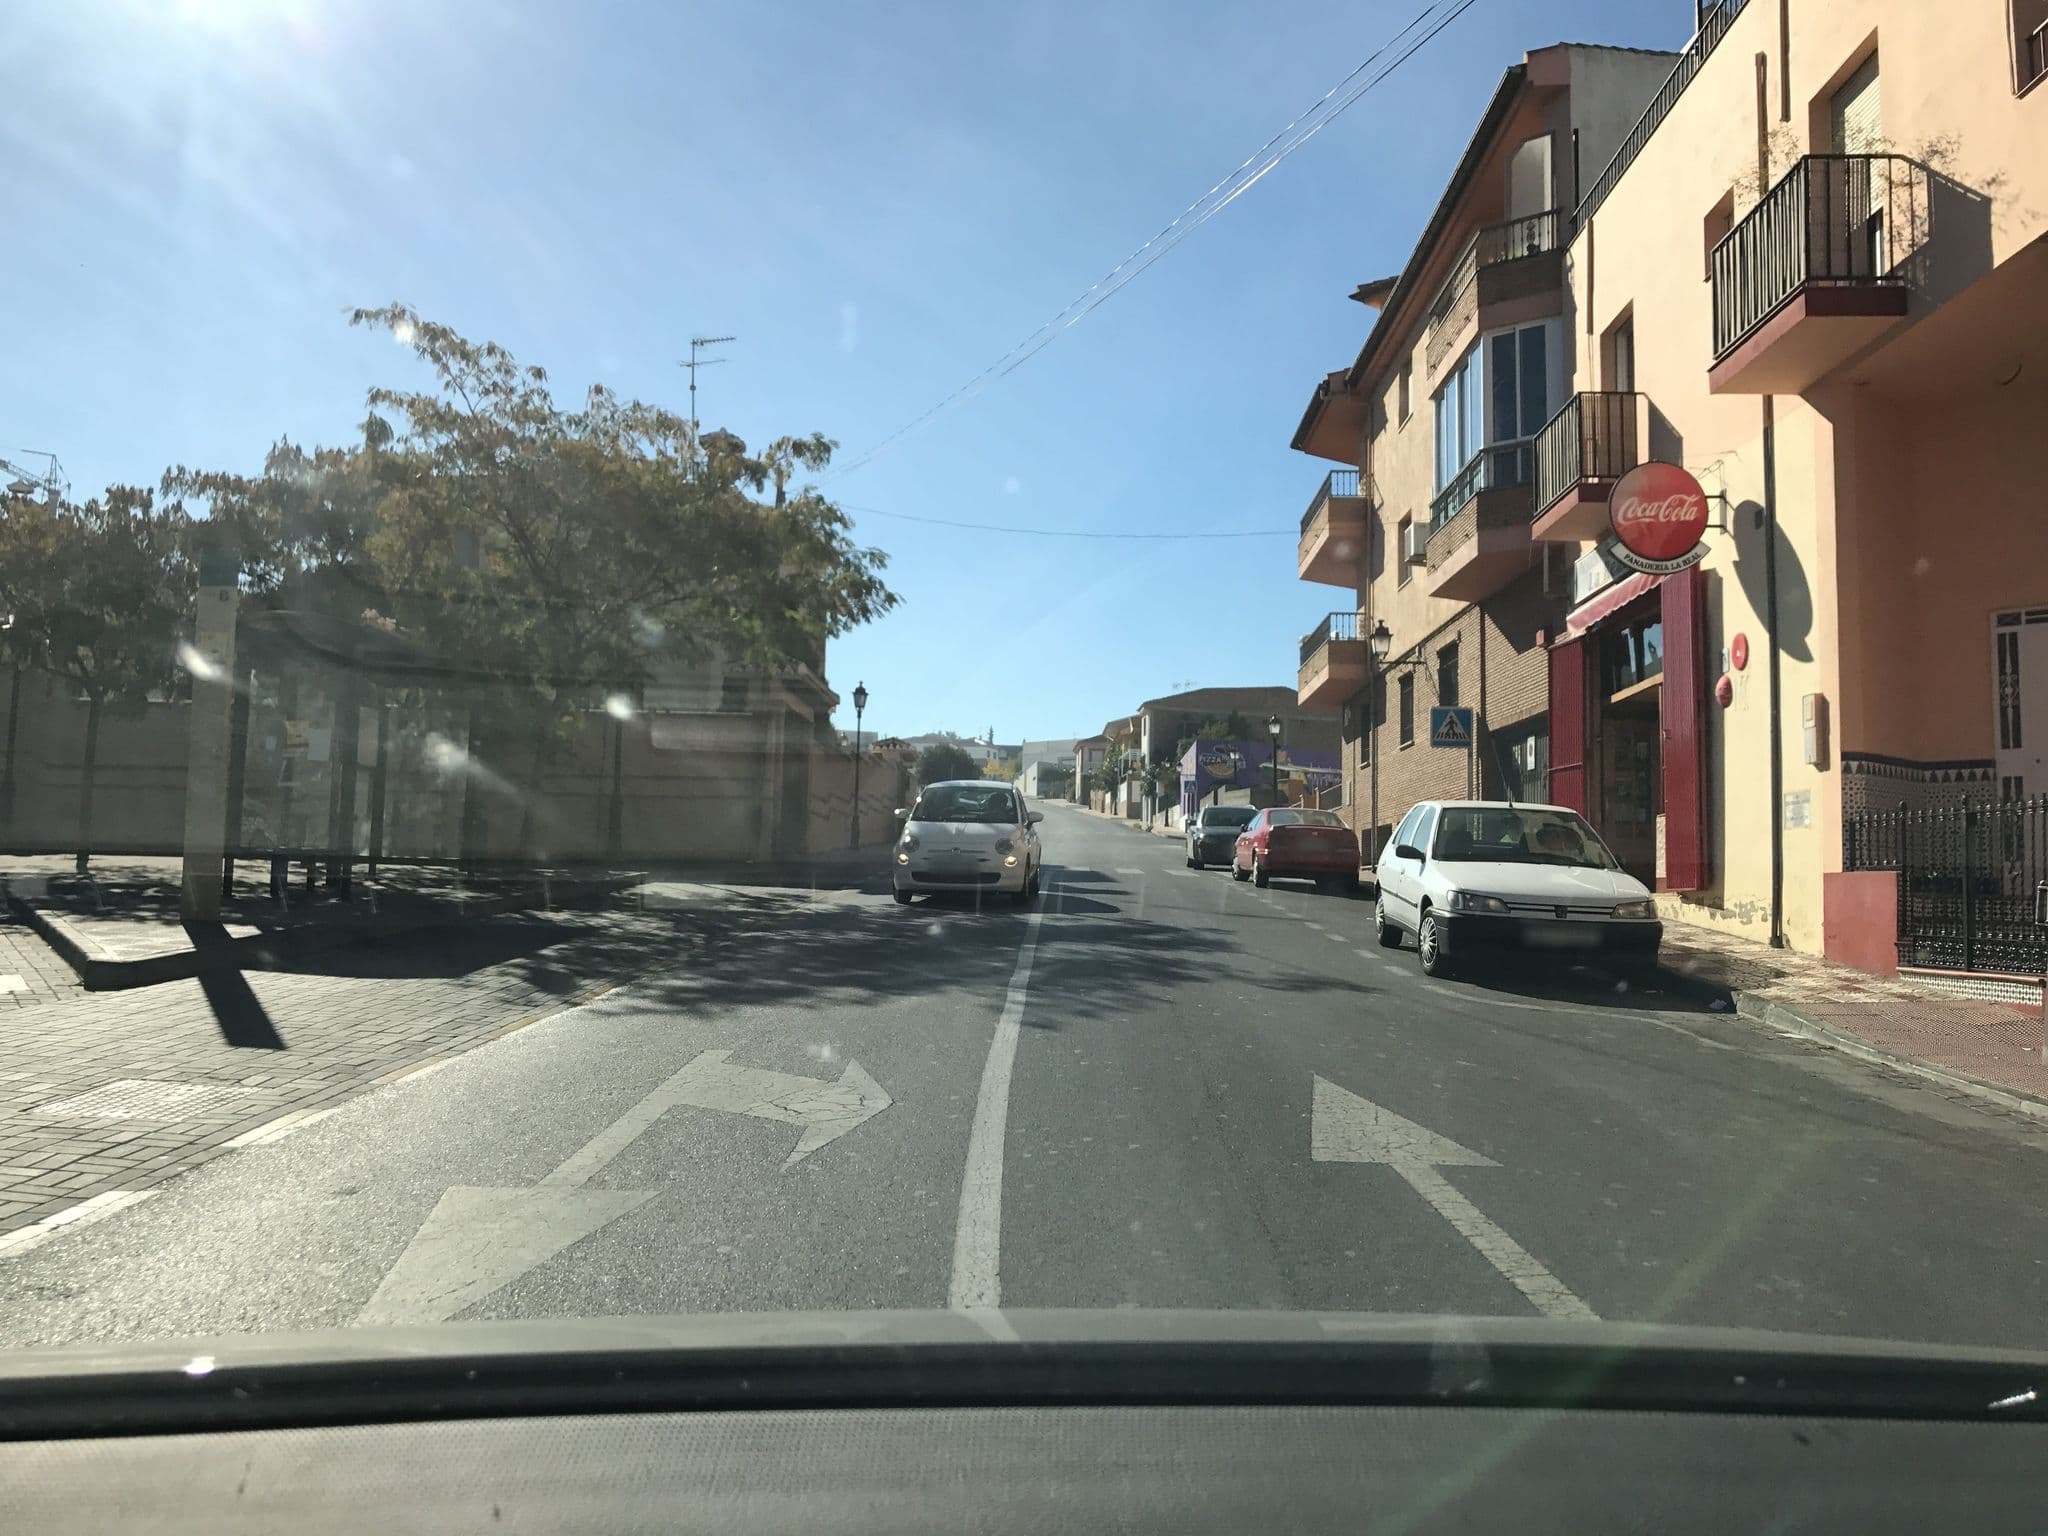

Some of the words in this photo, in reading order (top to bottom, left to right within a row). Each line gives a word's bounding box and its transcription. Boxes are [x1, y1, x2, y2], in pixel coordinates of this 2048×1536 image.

[1624, 553, 1669, 570] PANADERIA
[1671, 562, 1682, 570] LA
[1683, 553, 1701, 566] REAL
